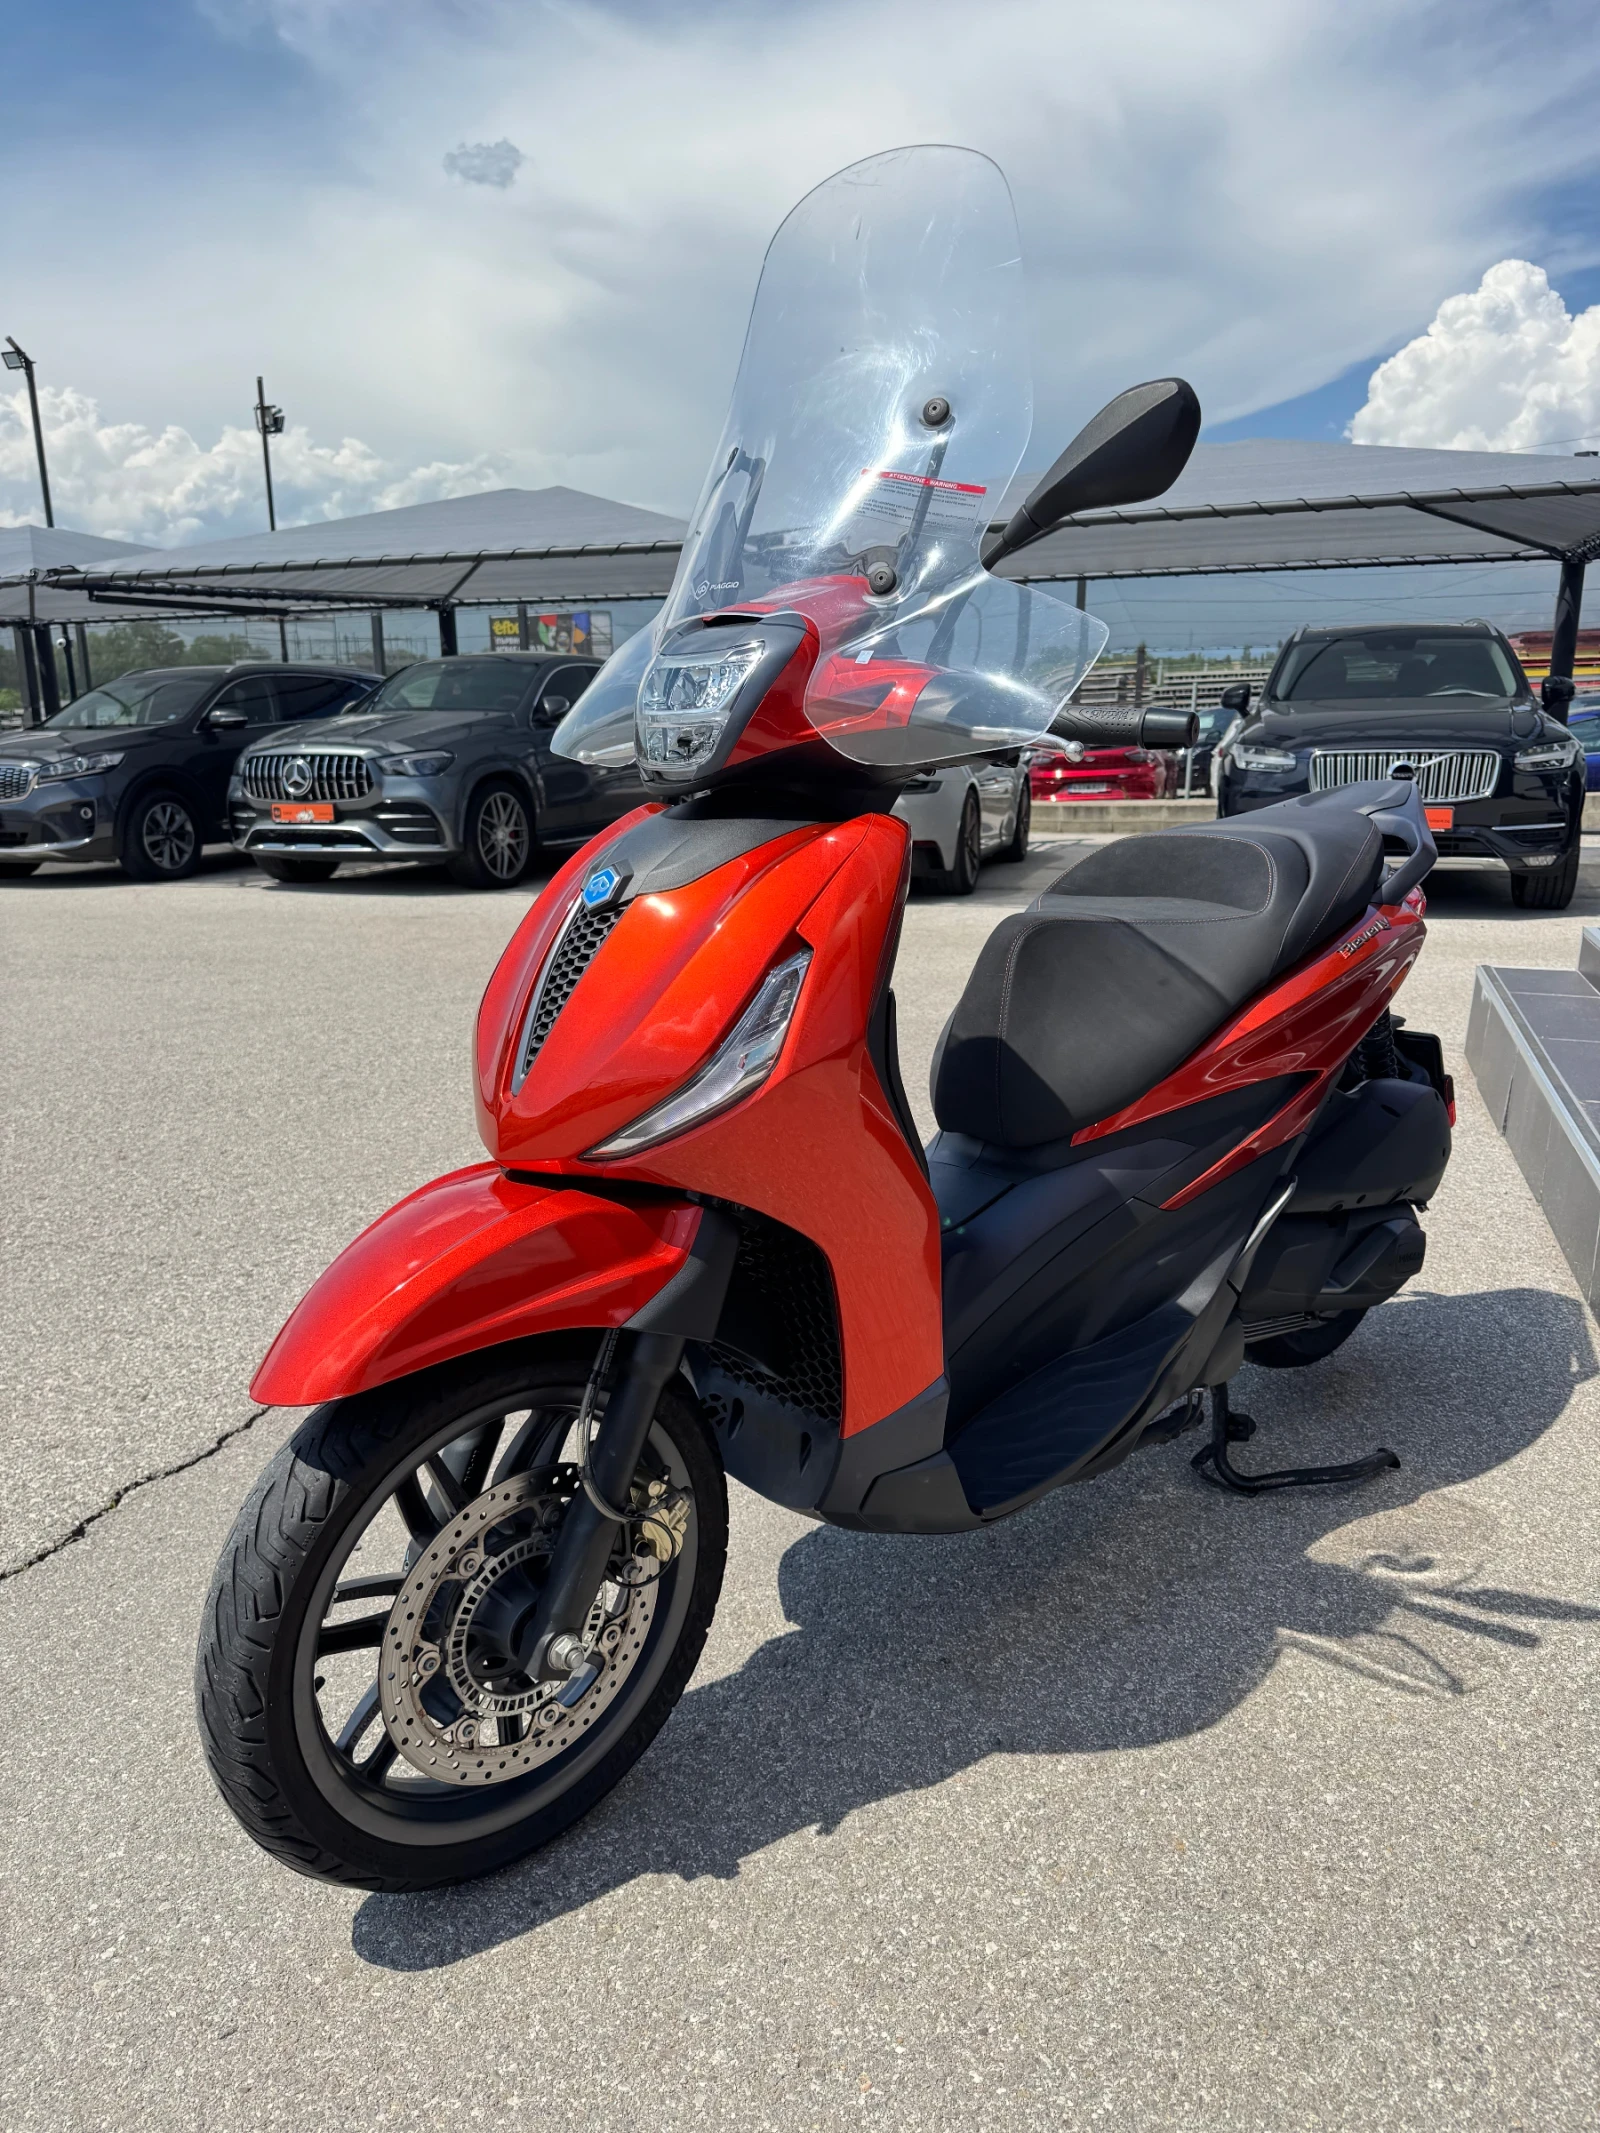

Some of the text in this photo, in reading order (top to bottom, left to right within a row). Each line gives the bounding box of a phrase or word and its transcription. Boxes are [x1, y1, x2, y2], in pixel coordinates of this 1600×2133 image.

[888, 473, 957, 489] ATTENZIONE WARNING
[709, 581, 740, 591] PIAGGIO
[1338, 916, 1392, 960] Beverly
